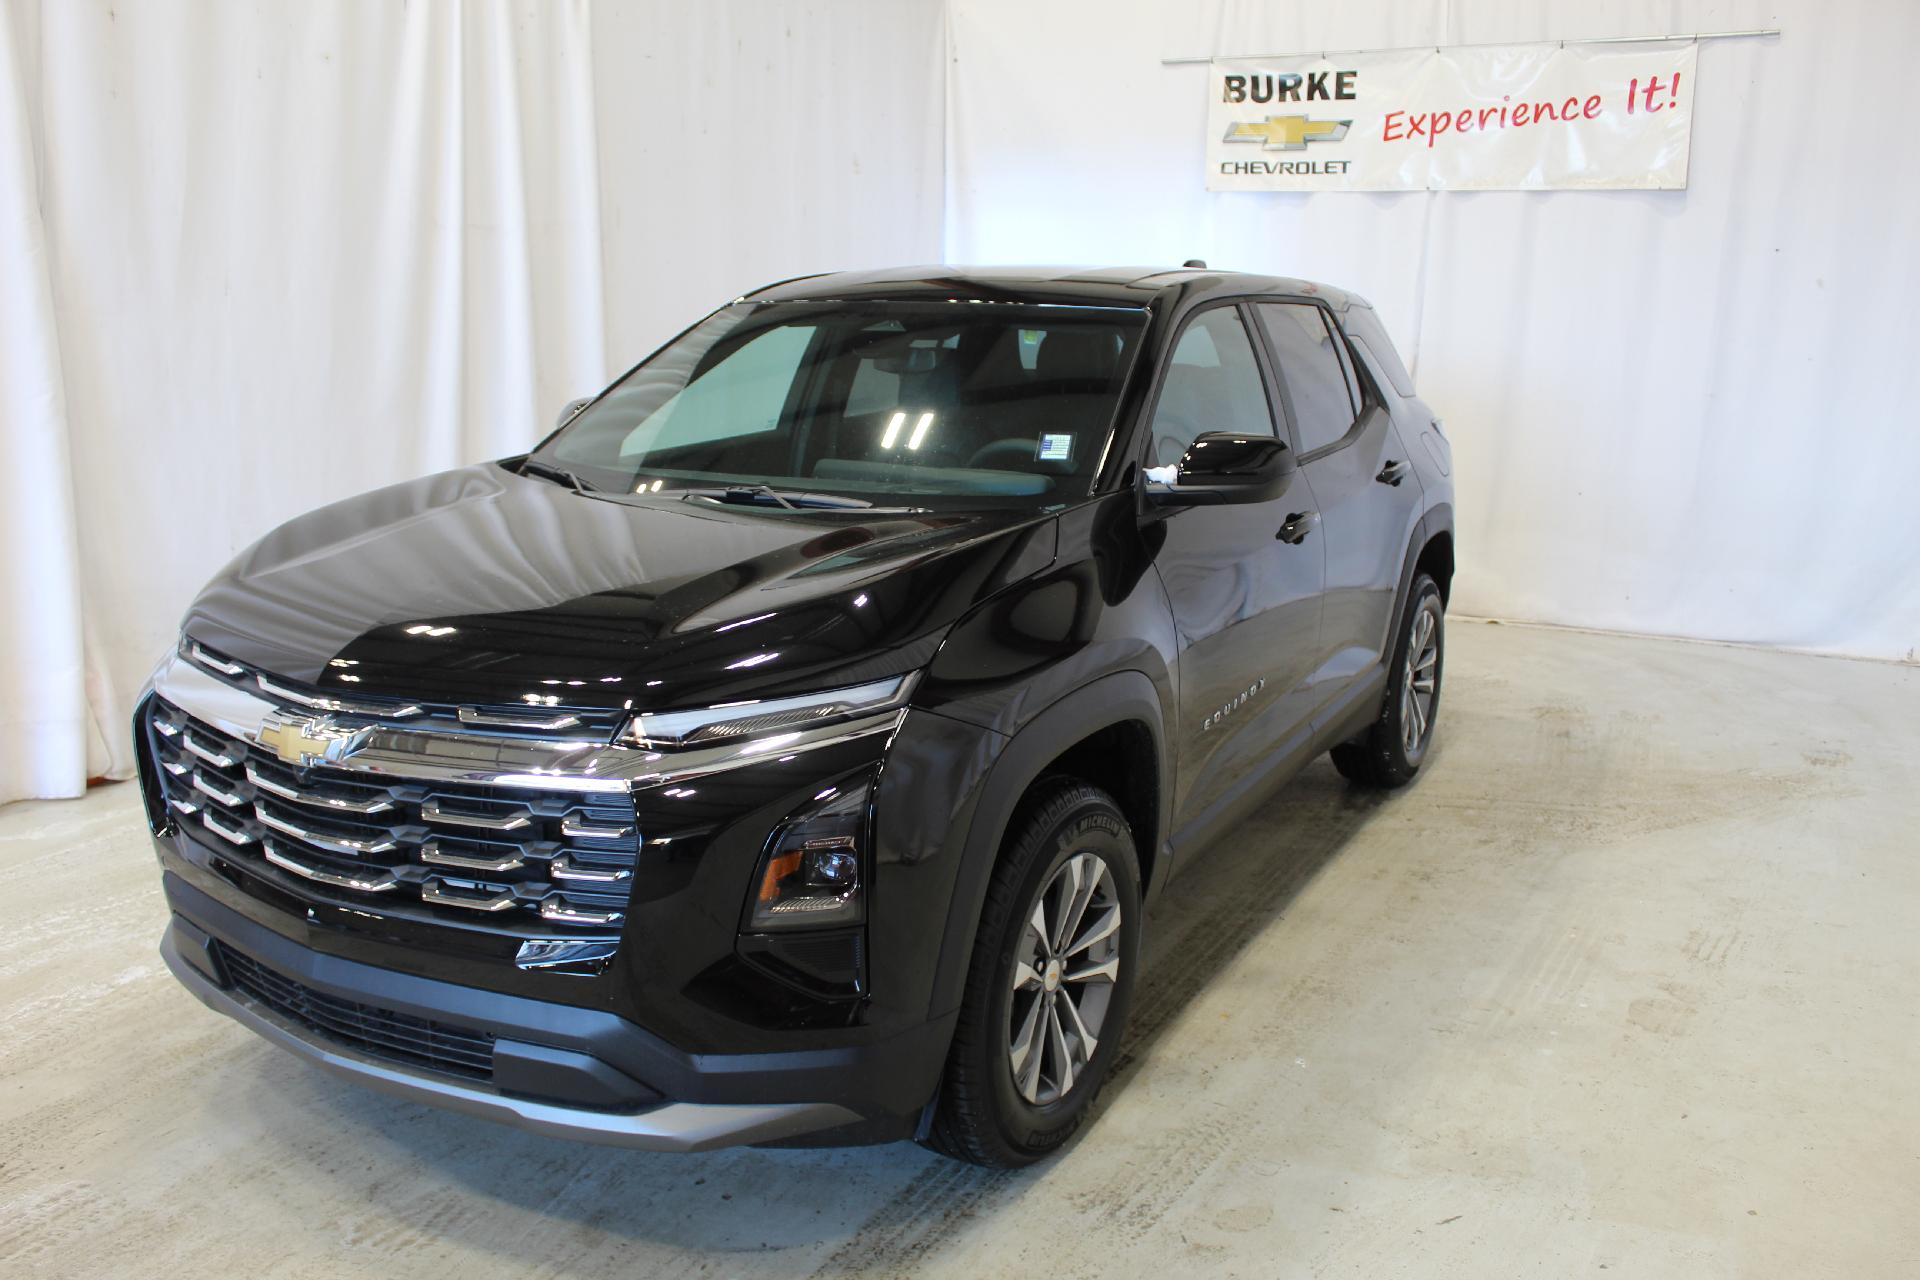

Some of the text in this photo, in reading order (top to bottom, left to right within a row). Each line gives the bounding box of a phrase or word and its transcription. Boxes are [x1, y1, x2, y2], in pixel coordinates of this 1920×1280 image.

[1223, 70, 1358, 103] BURKE
[1382, 72, 1681, 148] Experience It!
[1220, 160, 1352, 175] CHEVROLET
[1203, 677, 1266, 731] EQUINOX
